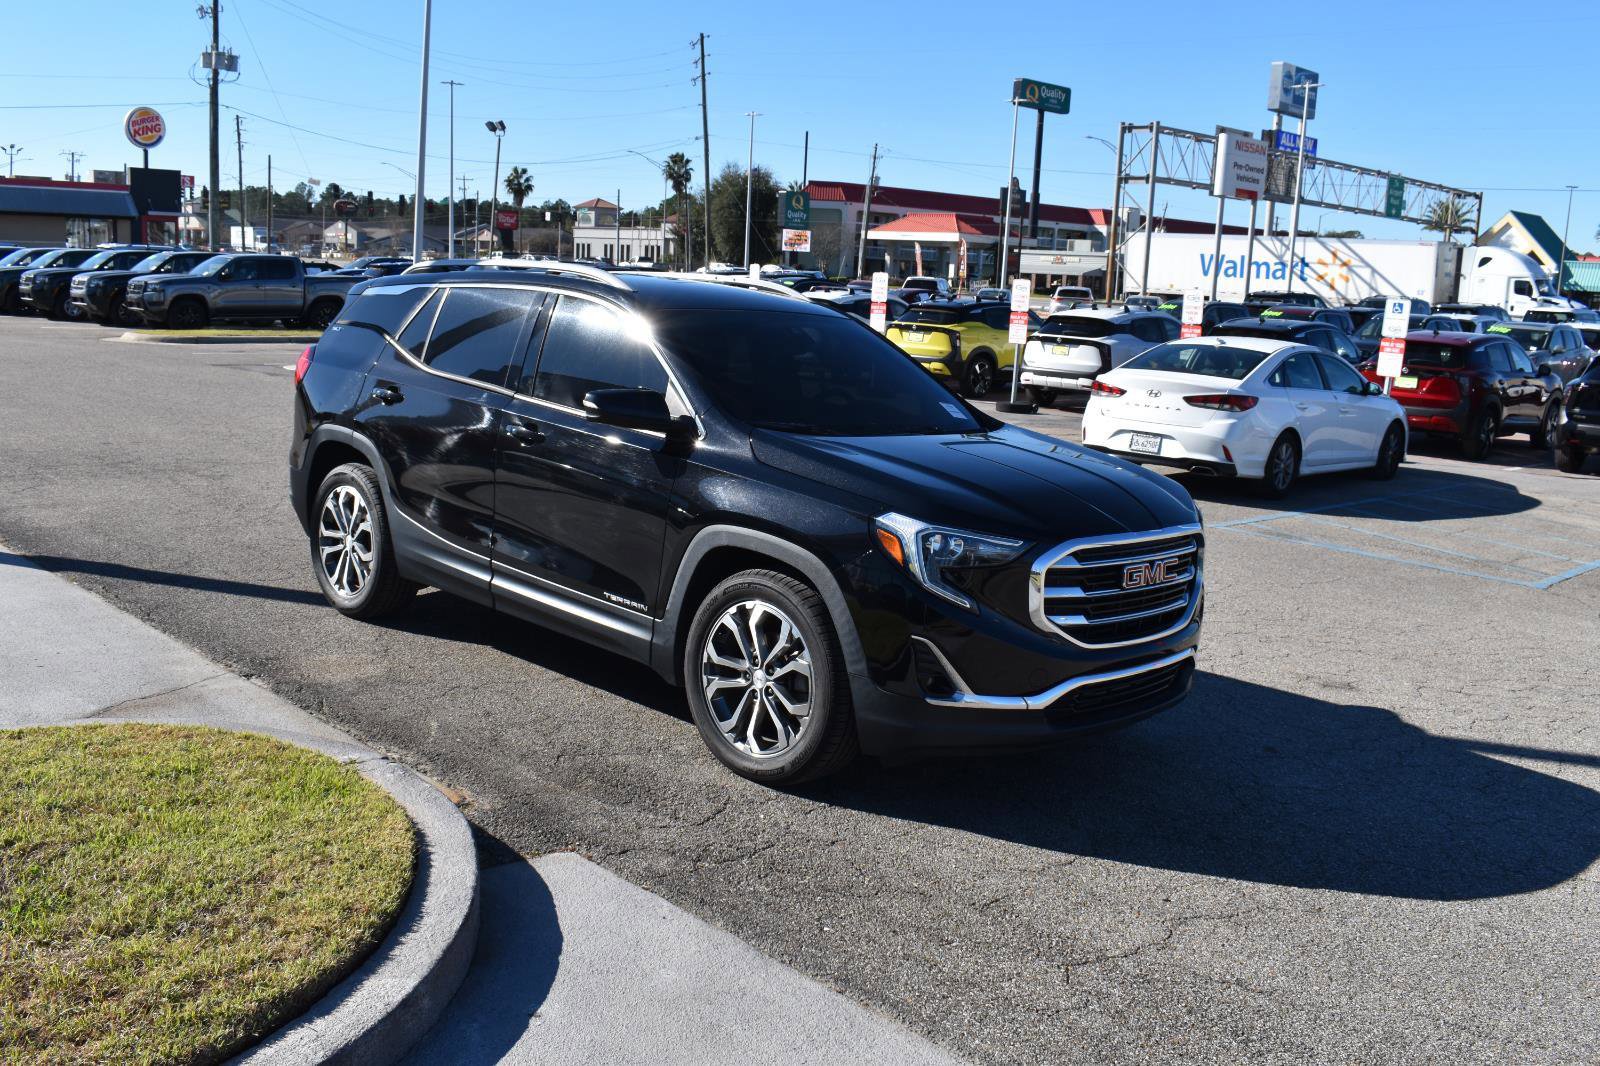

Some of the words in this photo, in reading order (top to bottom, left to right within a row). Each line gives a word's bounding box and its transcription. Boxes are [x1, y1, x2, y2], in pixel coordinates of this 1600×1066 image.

[1040, 85, 1066, 102] Quality
[131, 115, 161, 128] BURGER
[133, 123, 162, 138] KING
[1280, 132, 1294, 147] ALL
[1235, 139, 1267, 156] NISSAN
[1233, 161, 1265, 175] Pre-Owned
[1236, 173, 1260, 185] Vehicles
[787, 209, 807, 220] Quality
[1200, 253, 1308, 282] Walmart
[1123, 558, 1179, 589] GMC
[603, 591, 648, 612] TERRAIN
